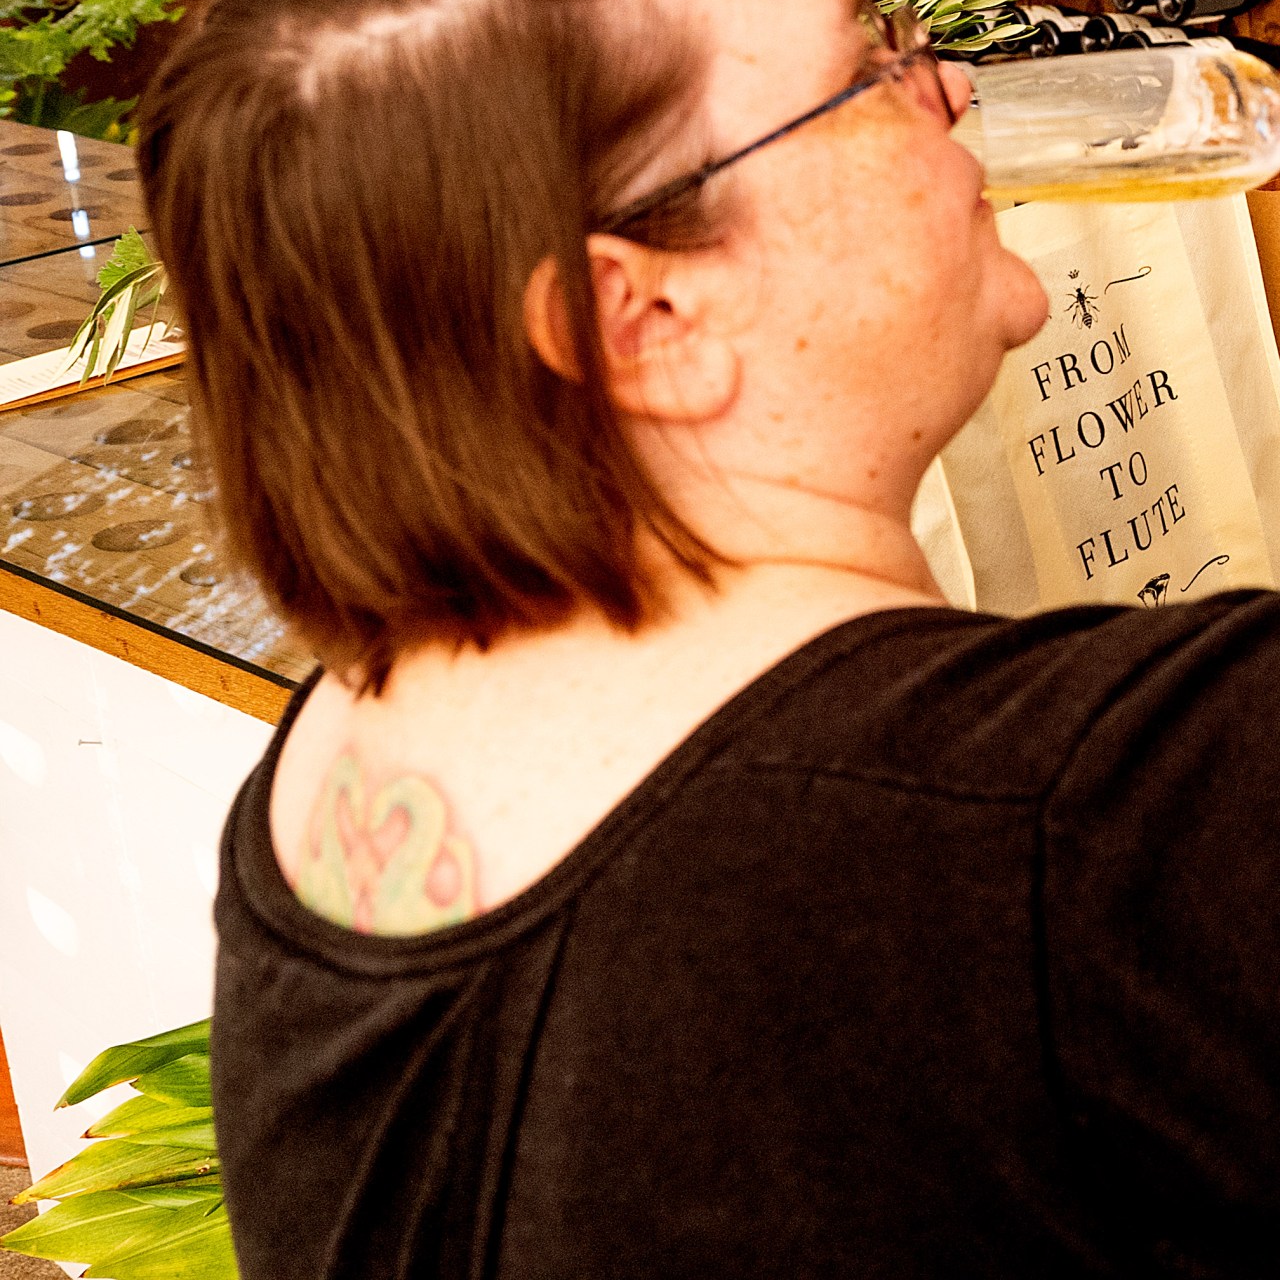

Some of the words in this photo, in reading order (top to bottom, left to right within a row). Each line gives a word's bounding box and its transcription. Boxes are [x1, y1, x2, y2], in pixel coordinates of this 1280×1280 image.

[1031, 323, 1133, 403] FROM
[1027, 369, 1179, 477] FLOWER
[1100, 451, 1149, 502] TO
[1076, 484, 1187, 581] FLUTE
